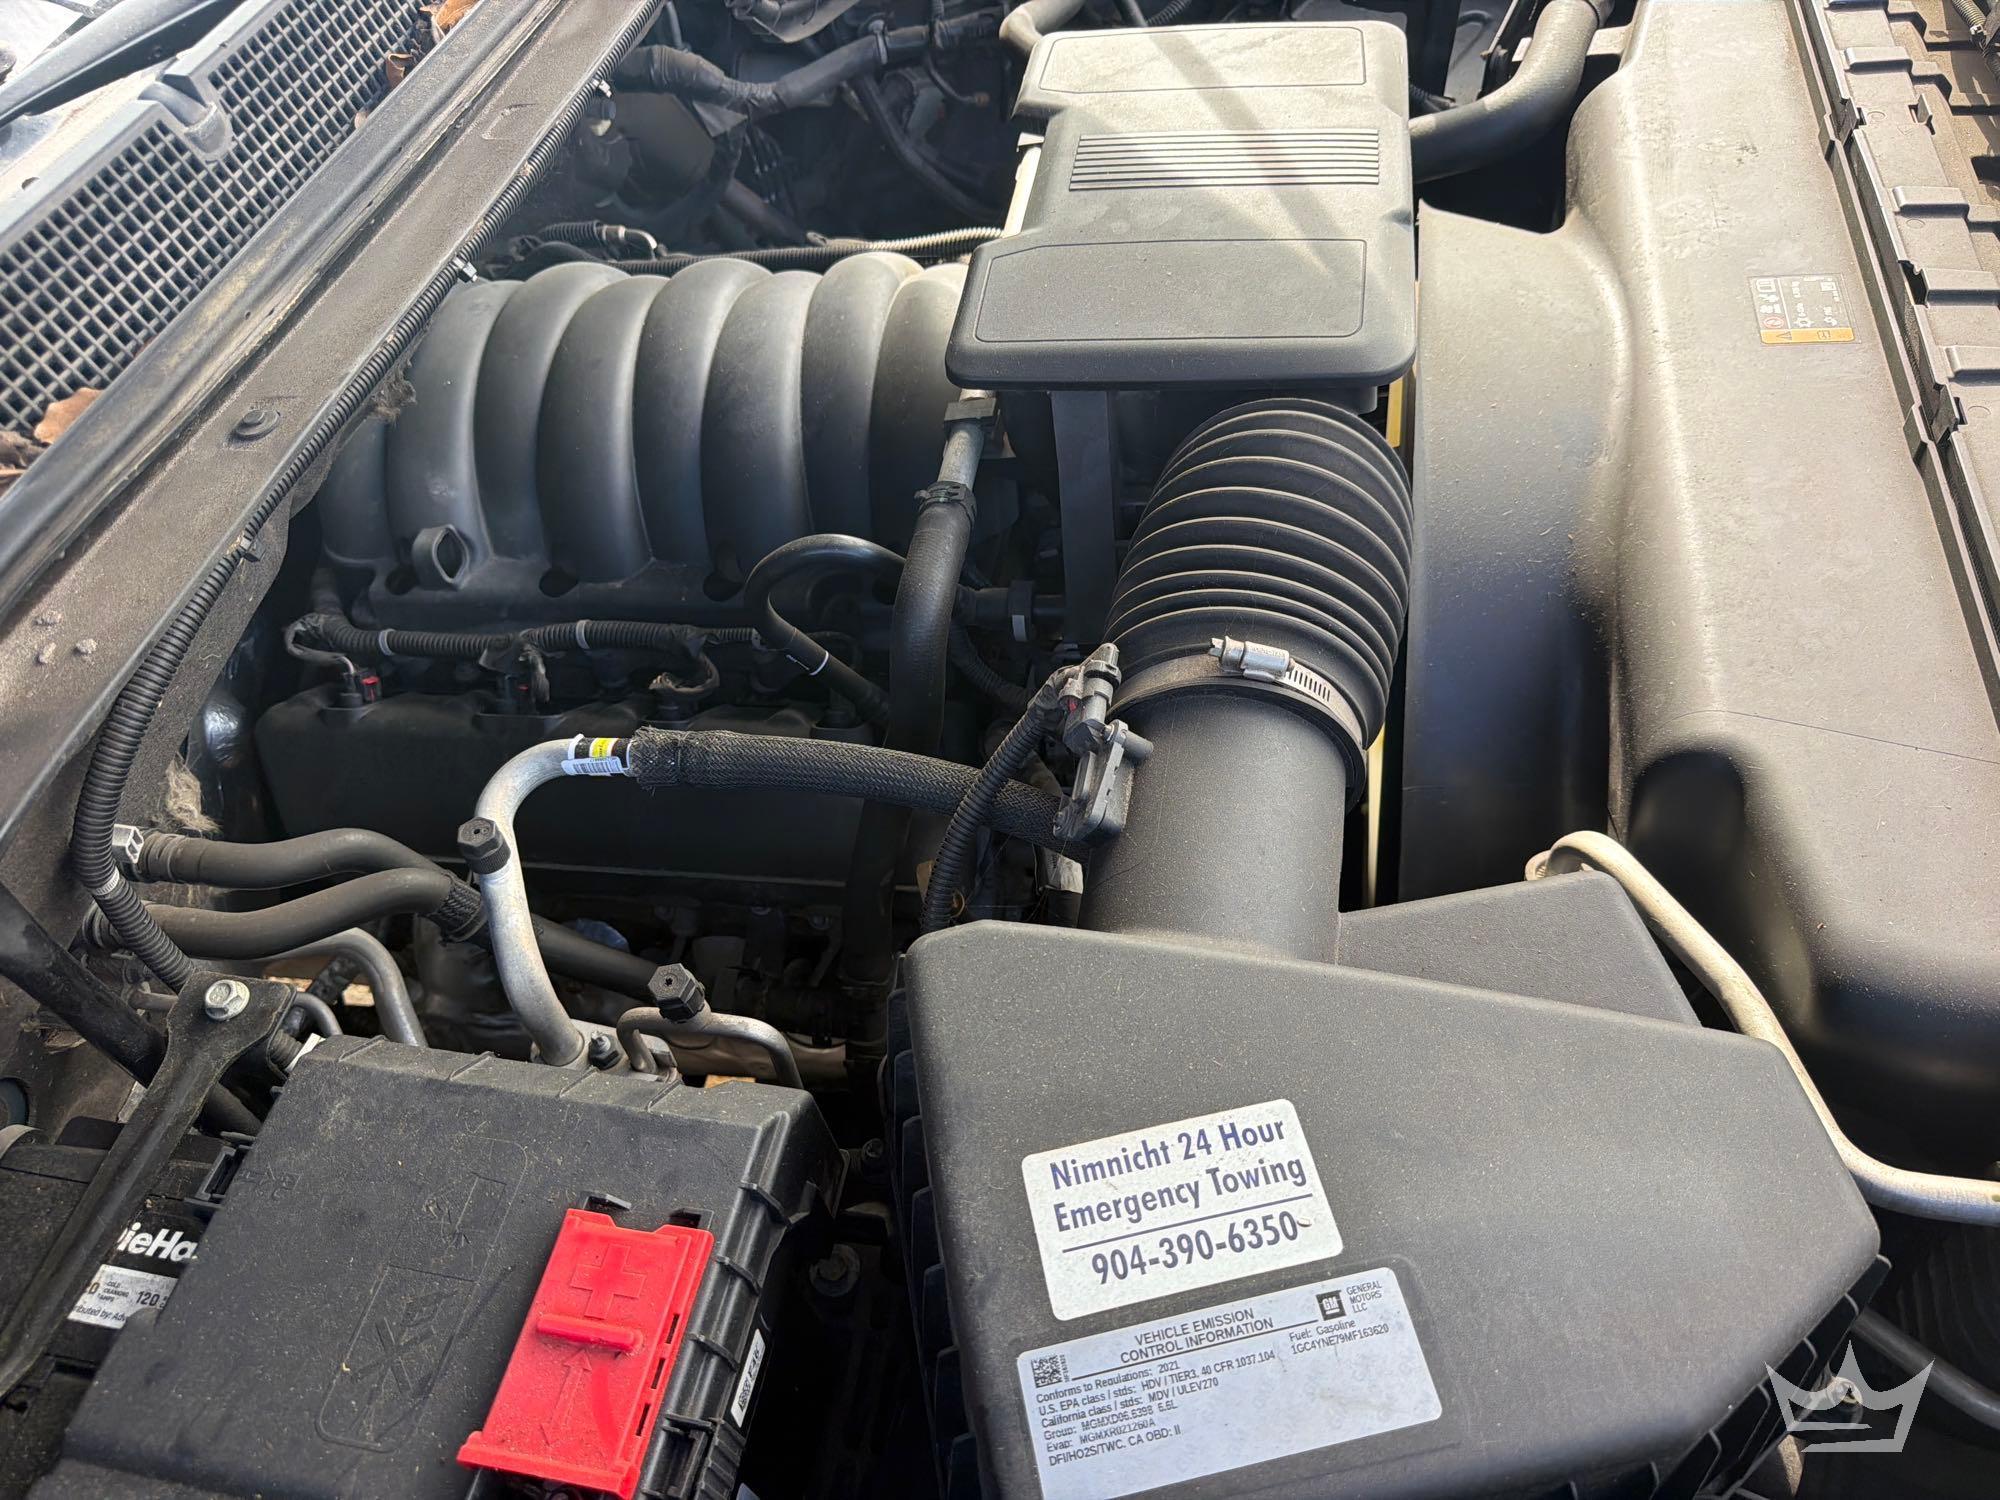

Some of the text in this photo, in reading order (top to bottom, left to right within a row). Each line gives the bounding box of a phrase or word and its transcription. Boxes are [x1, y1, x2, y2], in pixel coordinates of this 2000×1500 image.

[1050, 1119, 1286, 1190] Nimnicht 24 Hour
[1053, 1157, 1307, 1232] Emergency Towing
[1091, 1210, 1299, 1285] 904-390-6350
[1321, 1295, 1340, 1310] GM
[1346, 1280, 1383, 1296] GENERAL
[1349, 1290, 1383, 1305] MOTORS
[1351, 1302, 1368, 1314] LLC
[1120, 1317, 1274, 1364] CONTROL INFORMATION
[1134, 1308, 1255, 1346] VEHICLE EMISSION
[1289, 1320, 1357, 1342] Fuel: Gasoline
[1036, 1360, 1181, 1404] Conforms to Regulations: 2021
[1038, 1403, 1059, 1416] U.S.
[1060, 1398, 1080, 1411] EPA
[1081, 1391, 1106, 1406] class
[1113, 1385, 1137, 1398] stds:
[1141, 1377, 1162, 1391] HDV
[1201, 1365, 1212, 1376] 40
[1213, 1360, 1234, 1373] CFR
[1236, 1350, 1275, 1369] 1037.104
[1041, 1411, 1087, 1428] California
[1088, 1402, 1112, 1417] class
[1148, 1388, 1169, 1402] MDV
[1177, 1377, 1219, 1395] ULEV270
[1044, 1425, 1077, 1440] Group:
[1046, 1440, 1073, 1452] Evap:
[1128, 1434, 1144, 1446] CA
[1145, 1427, 1173, 1441] OBD:
